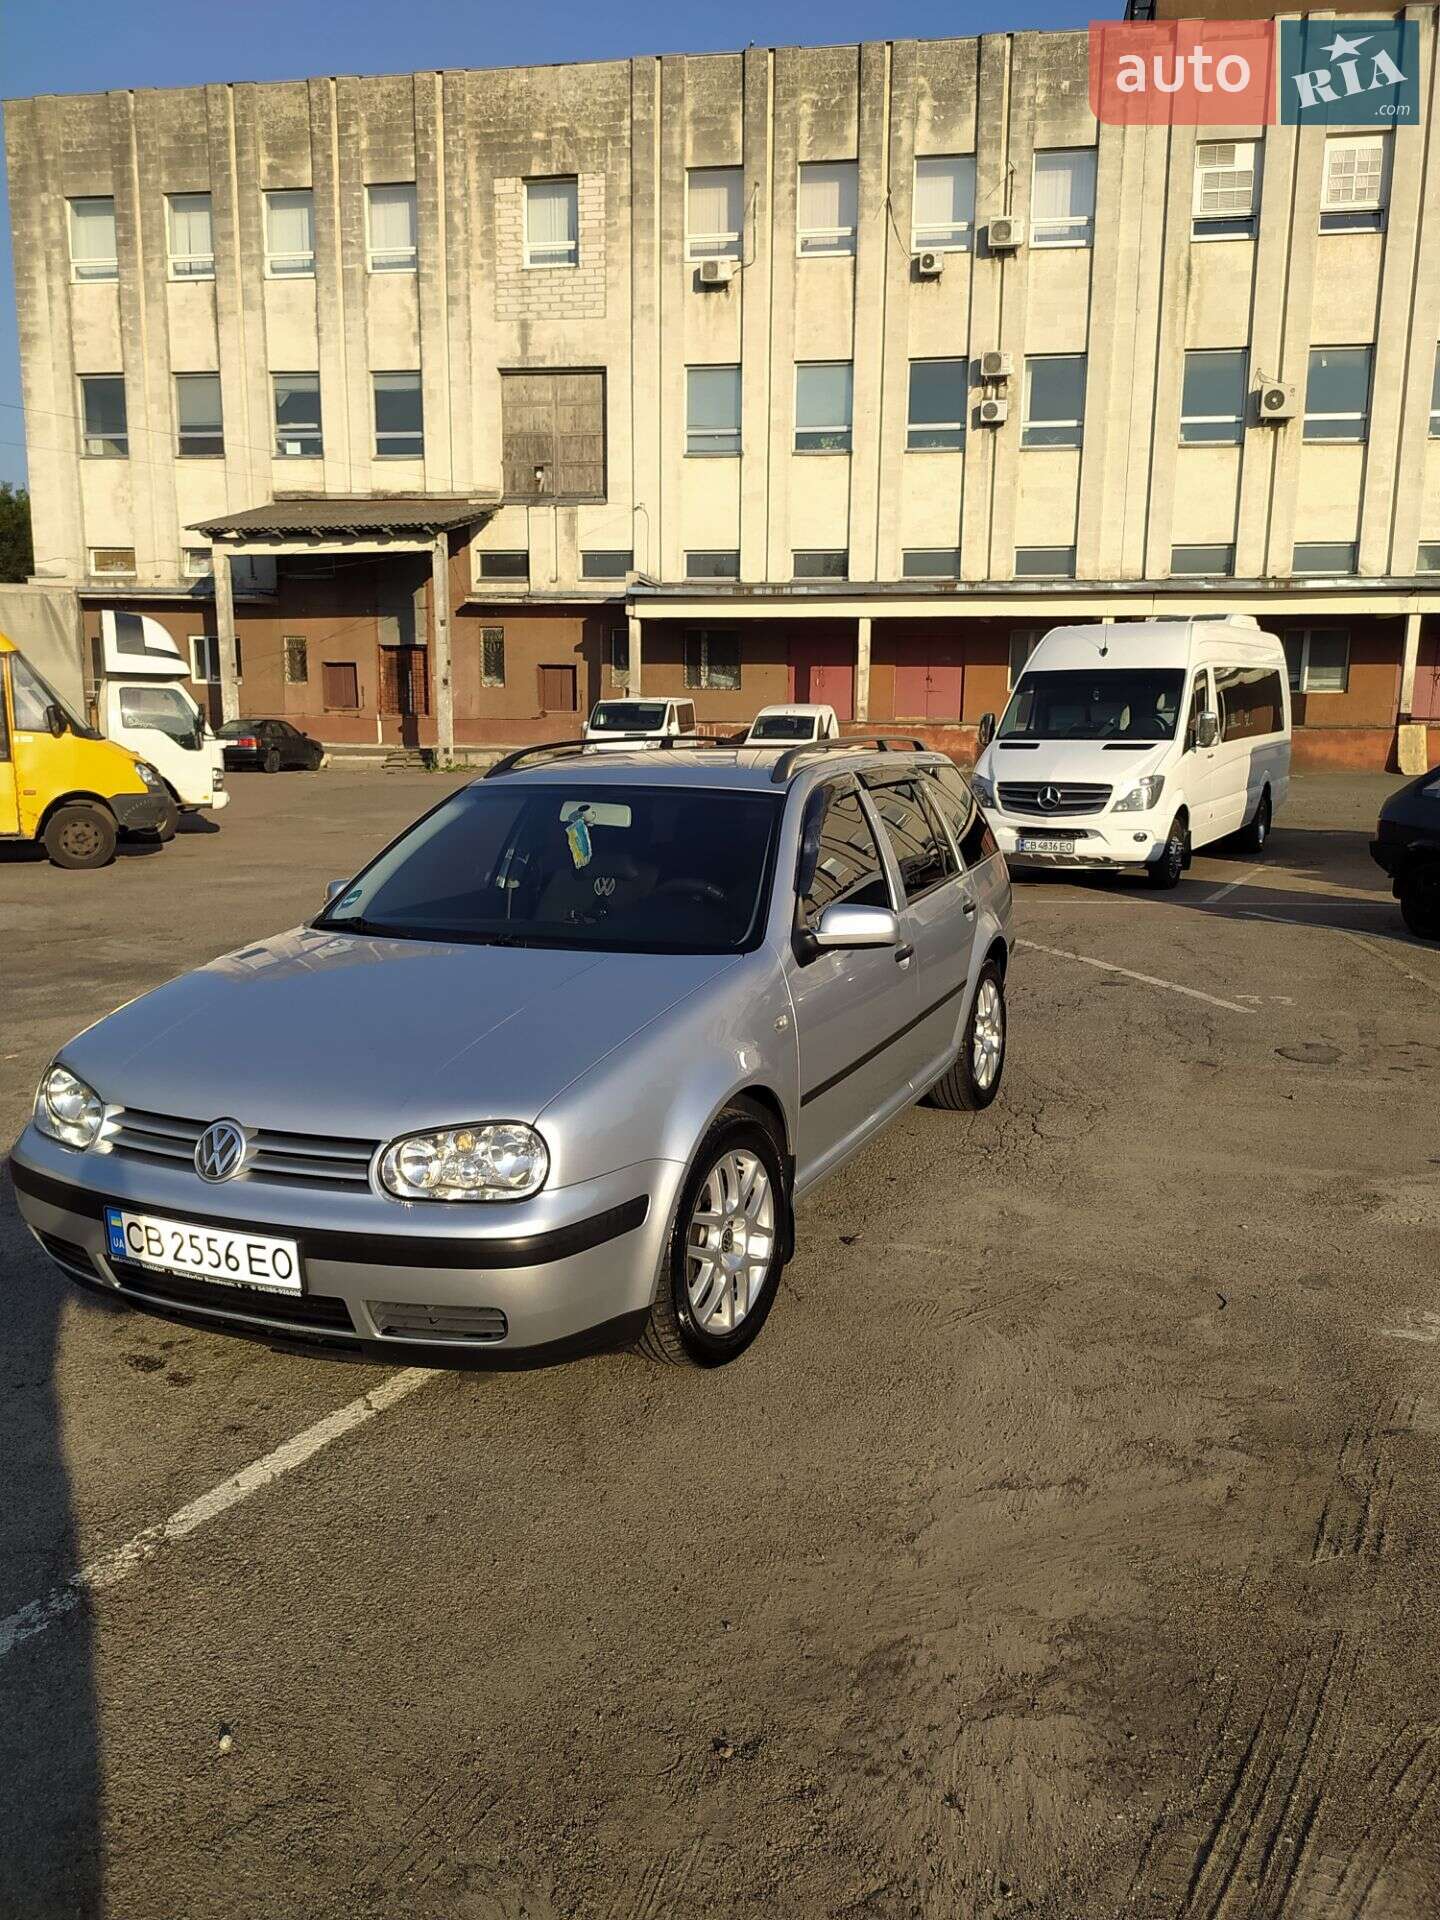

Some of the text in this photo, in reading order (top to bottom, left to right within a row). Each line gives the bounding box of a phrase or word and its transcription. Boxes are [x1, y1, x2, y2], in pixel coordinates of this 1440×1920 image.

[112, 1237, 125, 1249] UA
[126, 1221, 165, 1257] CB
[171, 1231, 240, 1272] 2556
[246, 1243, 293, 1280] EO
